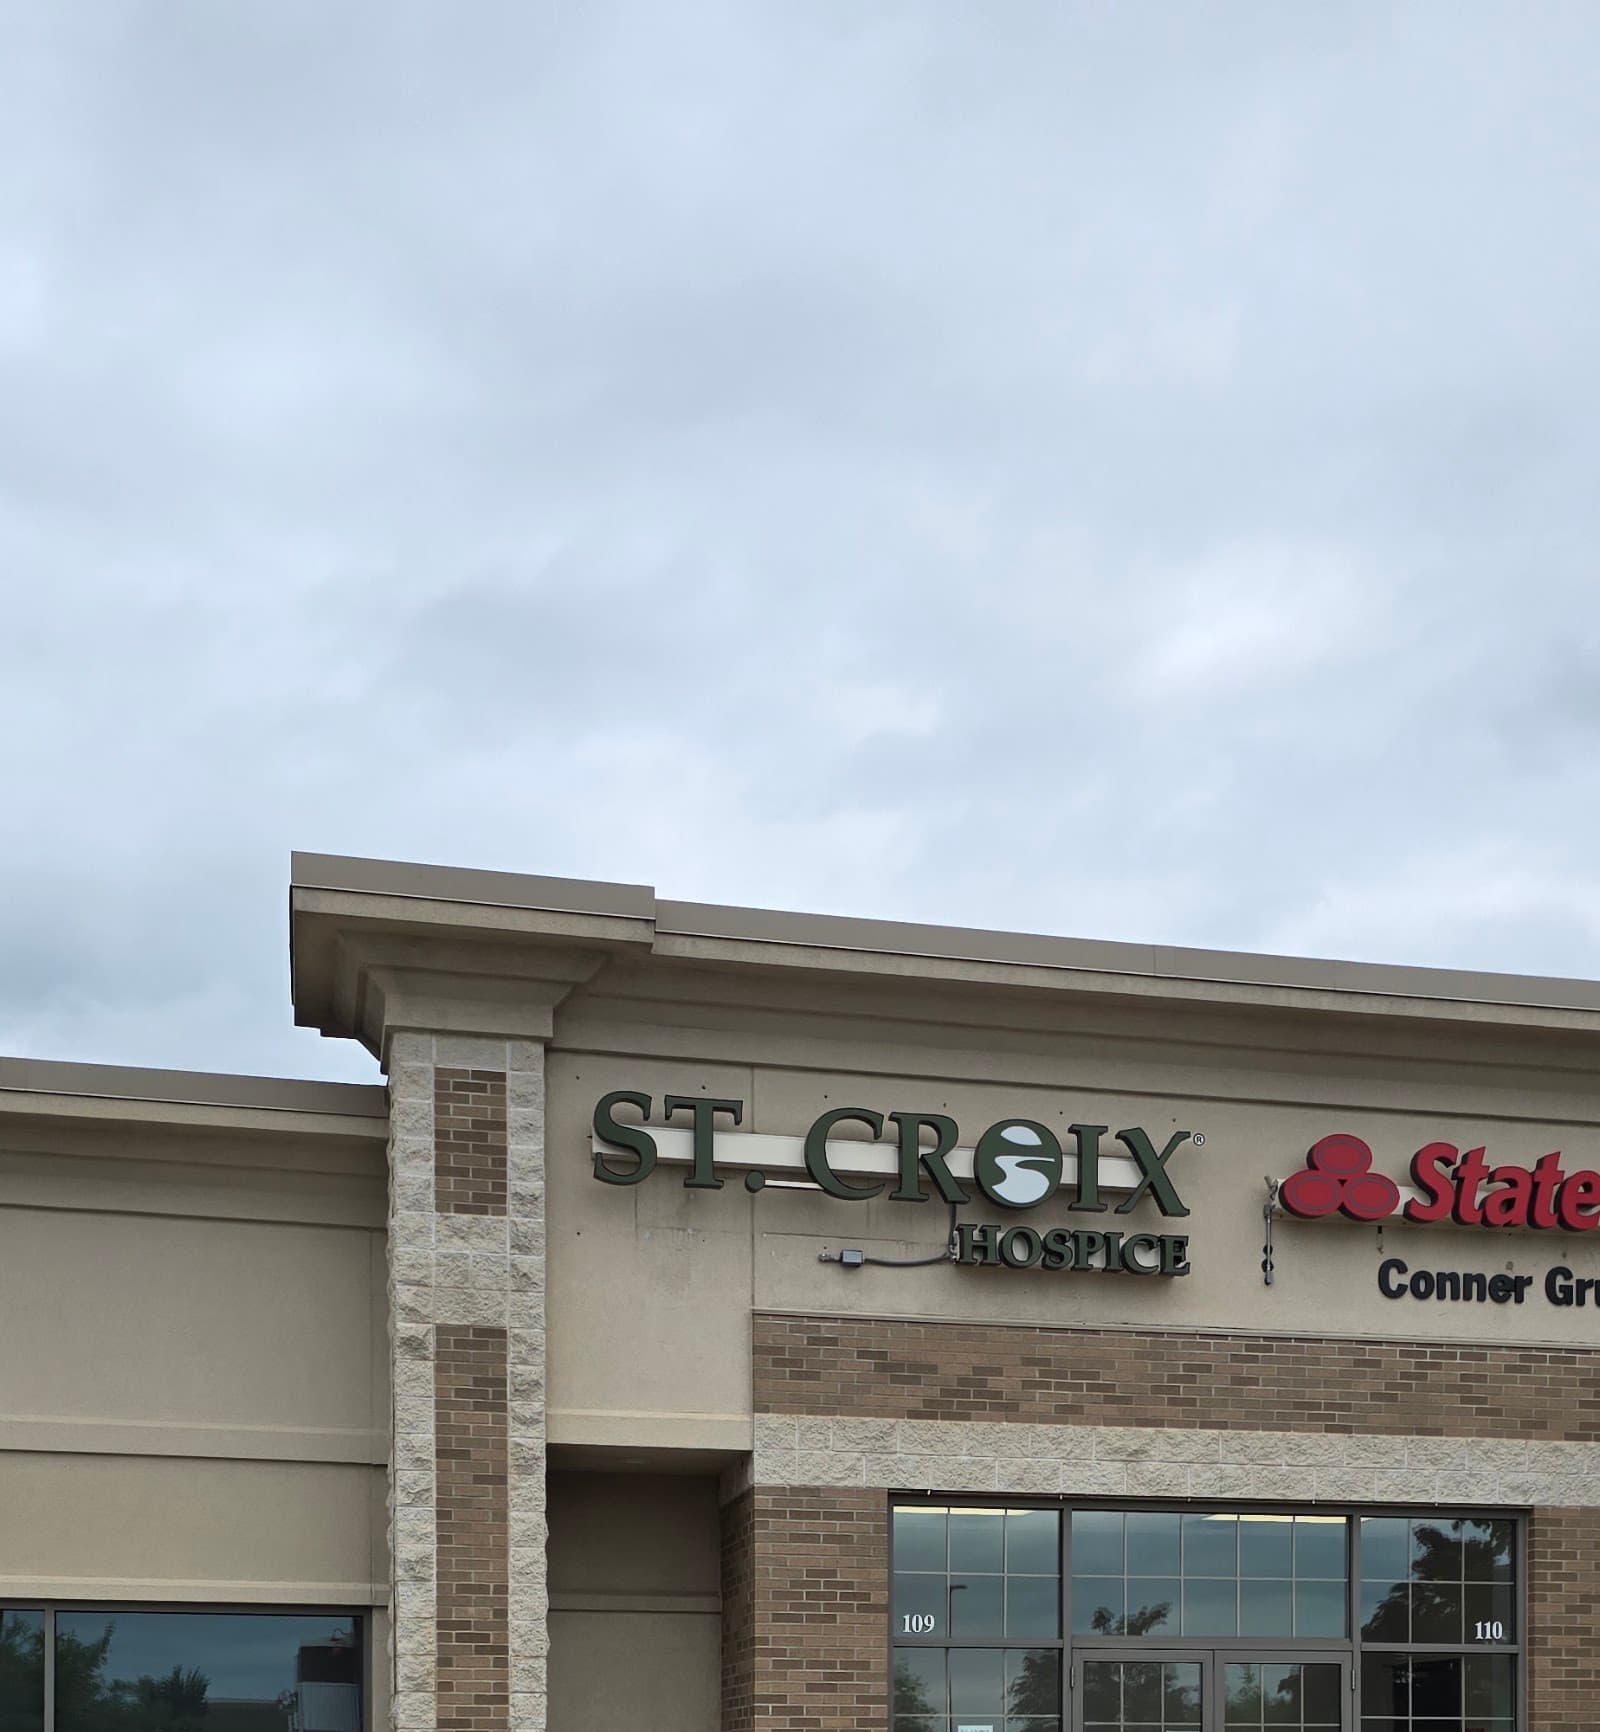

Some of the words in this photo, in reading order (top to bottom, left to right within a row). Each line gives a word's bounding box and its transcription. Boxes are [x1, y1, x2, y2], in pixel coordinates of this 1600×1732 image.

[592, 1090, 766, 1194] ST.
[804, 1106, 1191, 1217] CROIX
[1403, 1141, 1600, 1232] State
[956, 1223, 1191, 1276] HOSPICE
[1378, 1258, 1533, 1304] Conner
[1545, 1265, 1600, 1307] Gr
[902, 1614, 935, 1633] 109
[1474, 1621, 1503, 1640] 110
